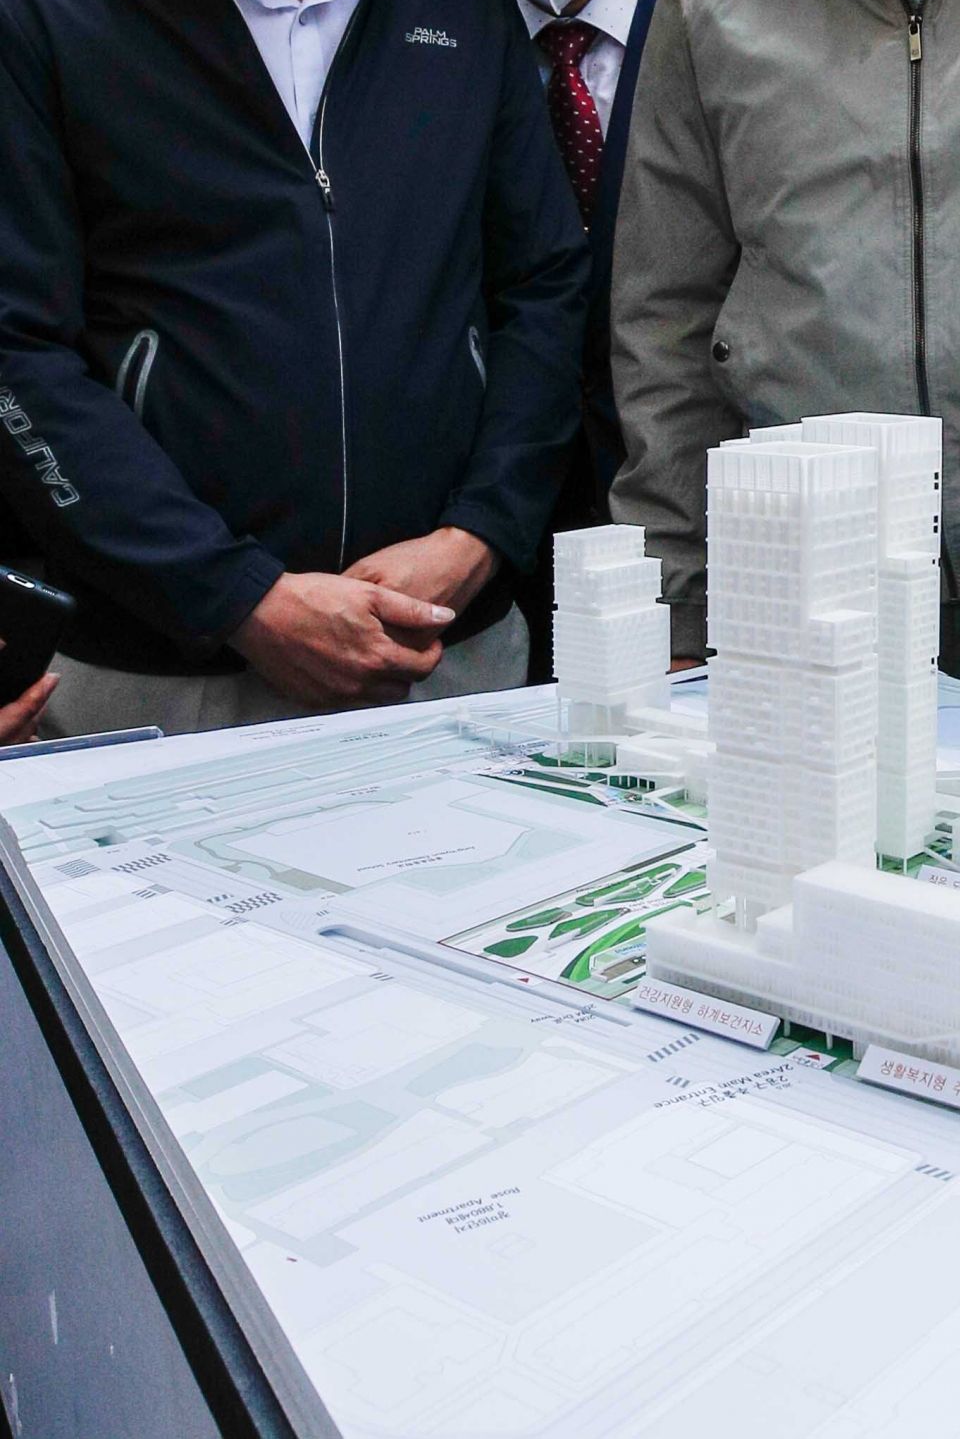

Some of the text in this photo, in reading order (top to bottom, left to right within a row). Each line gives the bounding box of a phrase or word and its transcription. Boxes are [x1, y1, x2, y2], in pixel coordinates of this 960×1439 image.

[404, 32, 458, 48] SPRINGS
[414, 26, 447, 38] PALM
[639, 985, 764, 1036] 건강지원형 하계보건지소
[717, 1074, 752, 1090] Main
[880, 1059, 948, 1092] 생활복지형
[653, 1085, 717, 1109] Entrance
[417, 1186, 521, 1223] Rose Apartment
